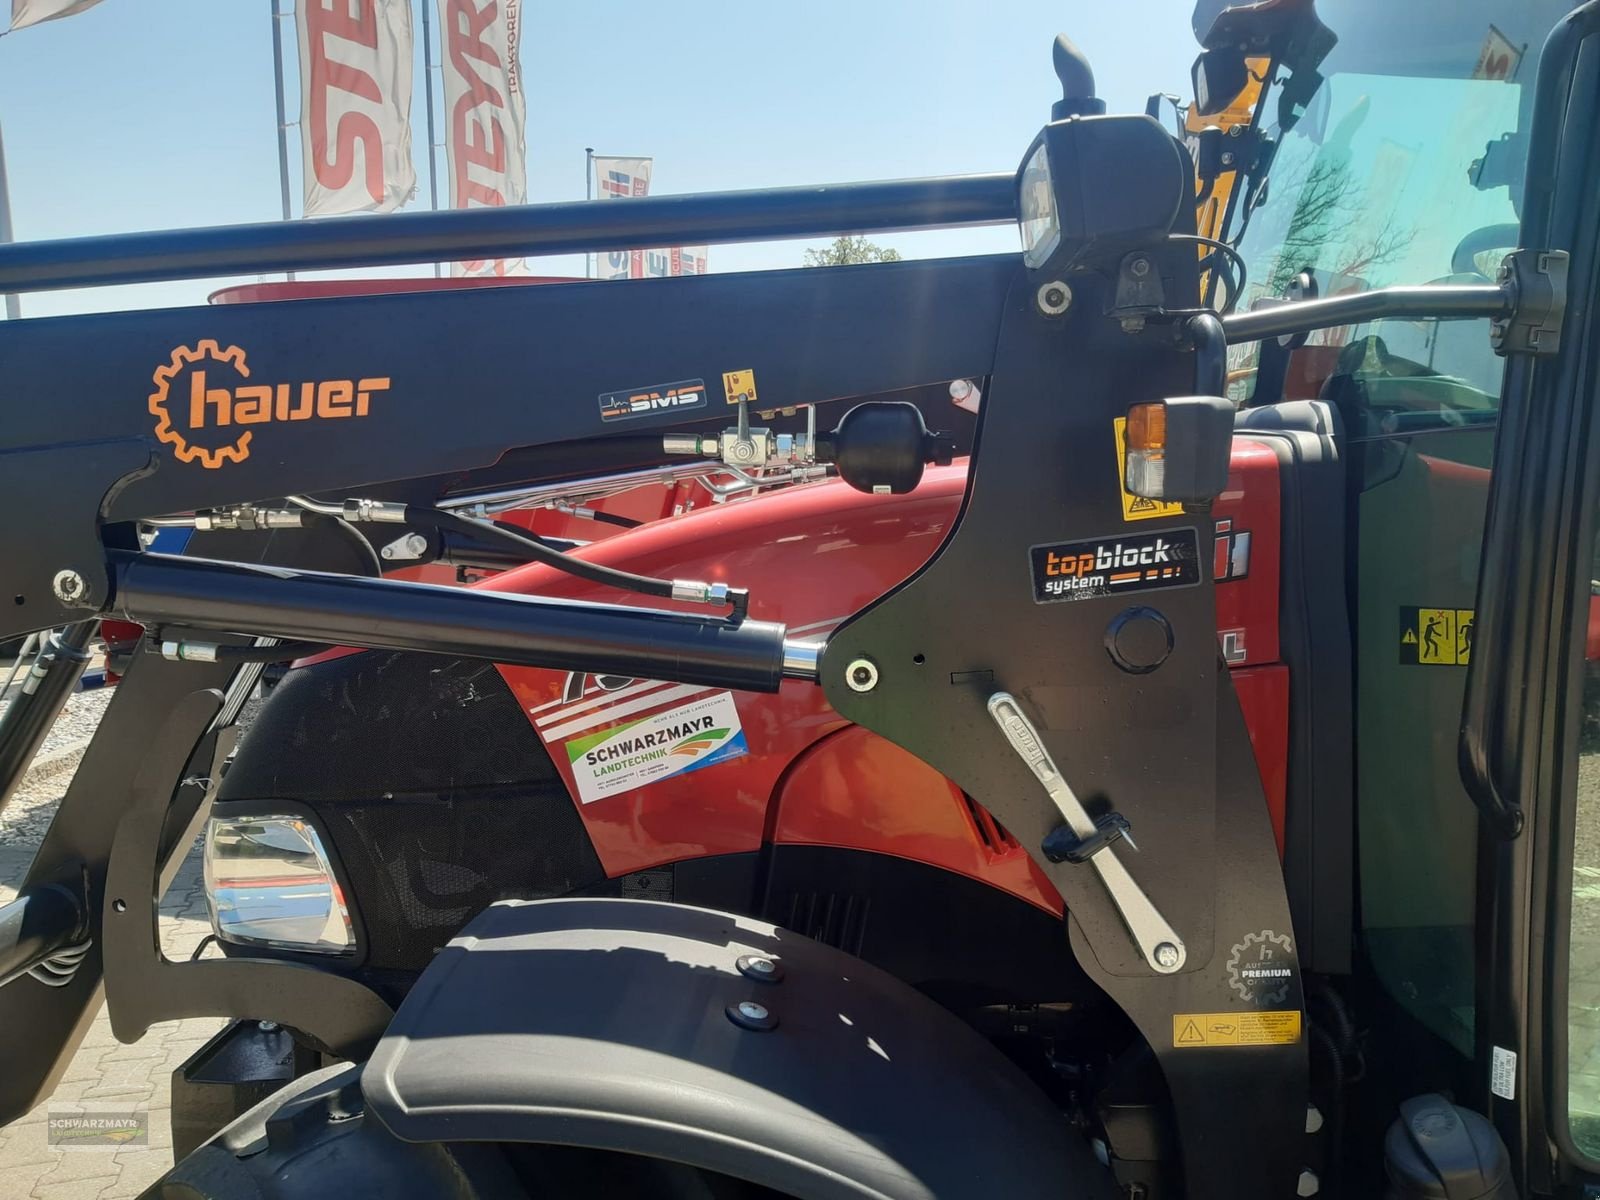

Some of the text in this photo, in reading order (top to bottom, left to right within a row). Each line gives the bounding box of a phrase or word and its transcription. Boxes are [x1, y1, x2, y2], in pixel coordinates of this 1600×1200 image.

[189, 377, 391, 429] hauer
[629, 385, 705, 411] SMS
[1046, 538, 1171, 577] topblock
[1044, 575, 1104, 595] system
[585, 715, 715, 766] SCHWARZMAYR
[593, 747, 668, 778] LANDTECHNIK
[1242, 969, 1291, 978] PREMIUM
